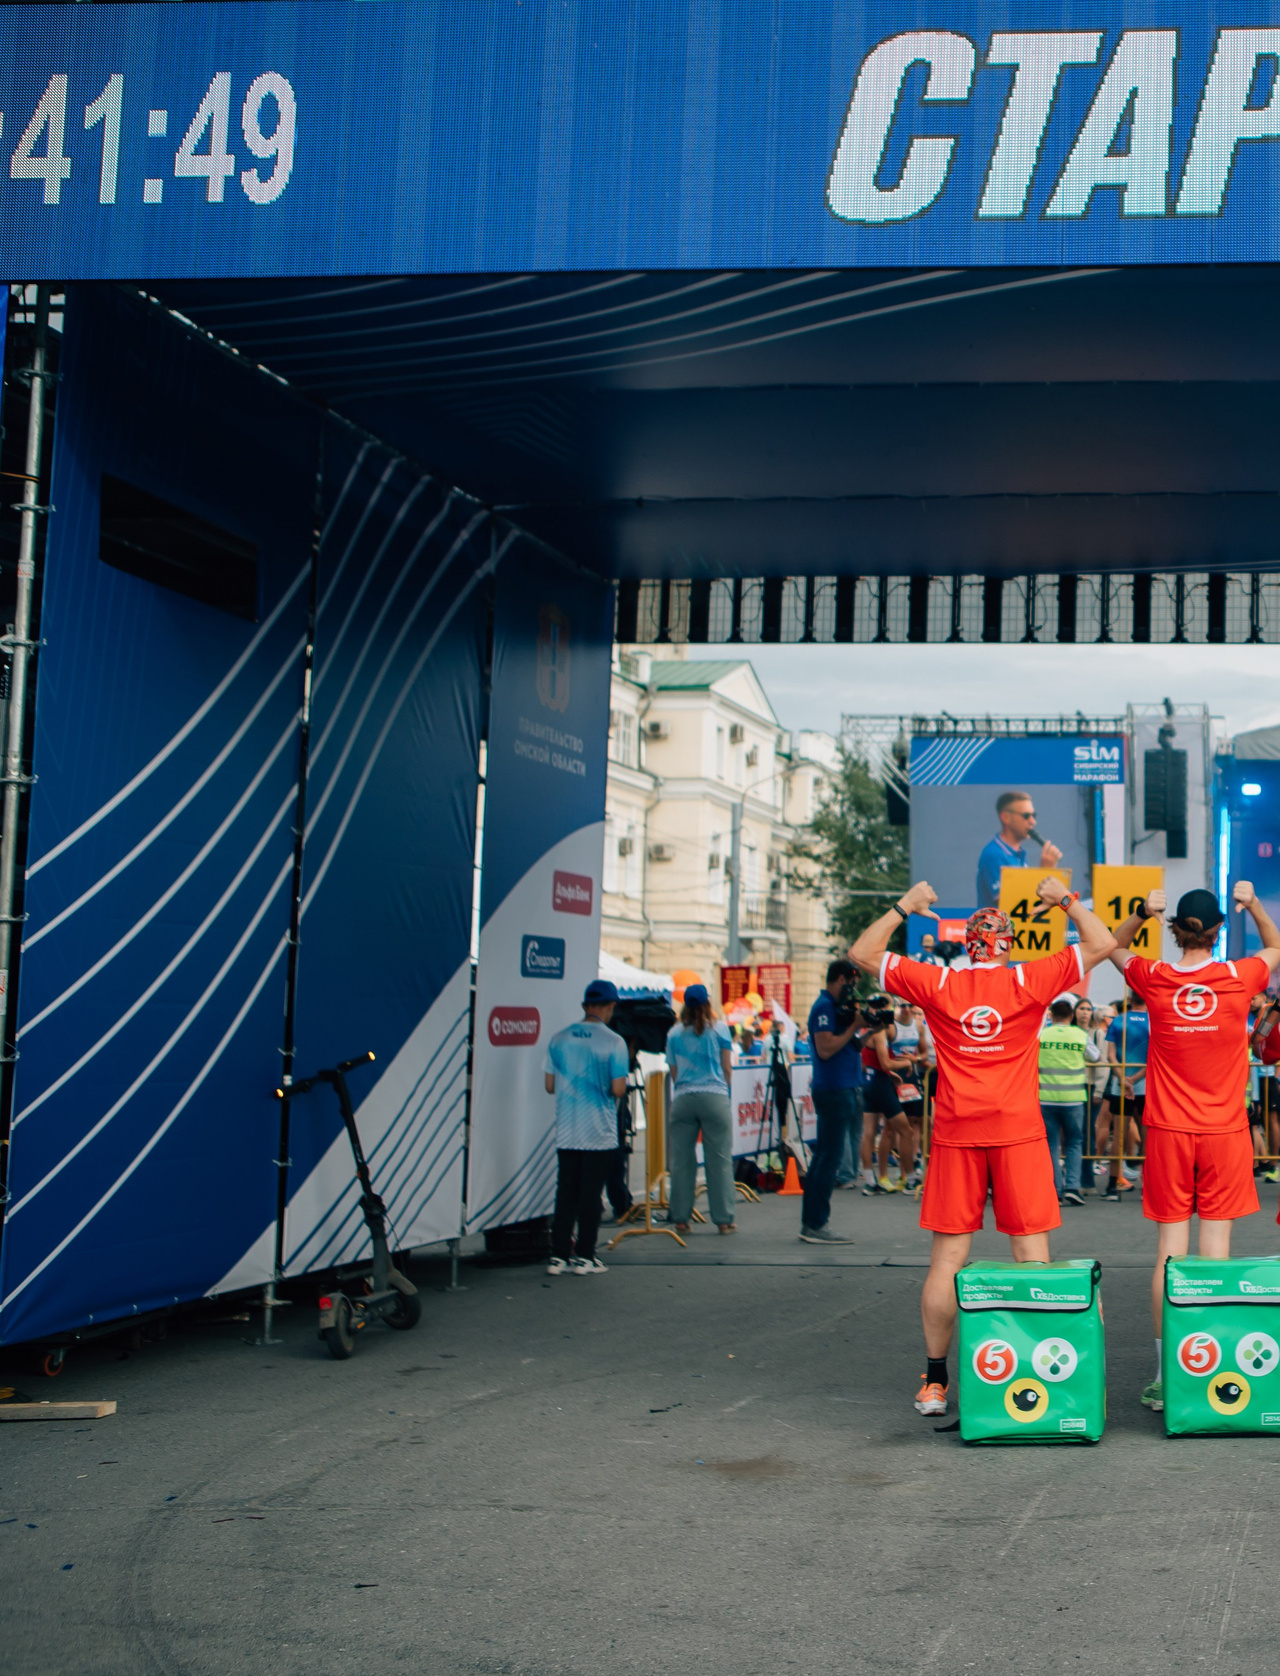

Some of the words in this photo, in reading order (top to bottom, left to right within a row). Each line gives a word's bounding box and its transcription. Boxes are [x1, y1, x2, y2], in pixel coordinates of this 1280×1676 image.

[0, 71, 297, 205] 41:49
[1010, 899, 1050, 924] 42
[1173, 1278, 1223, 1287] Доставляем
[962, 1283, 1014, 1292] Доставляем
[1173, 1287, 1213, 1295] продукты
[963, 1293, 1003, 1301] продукты
